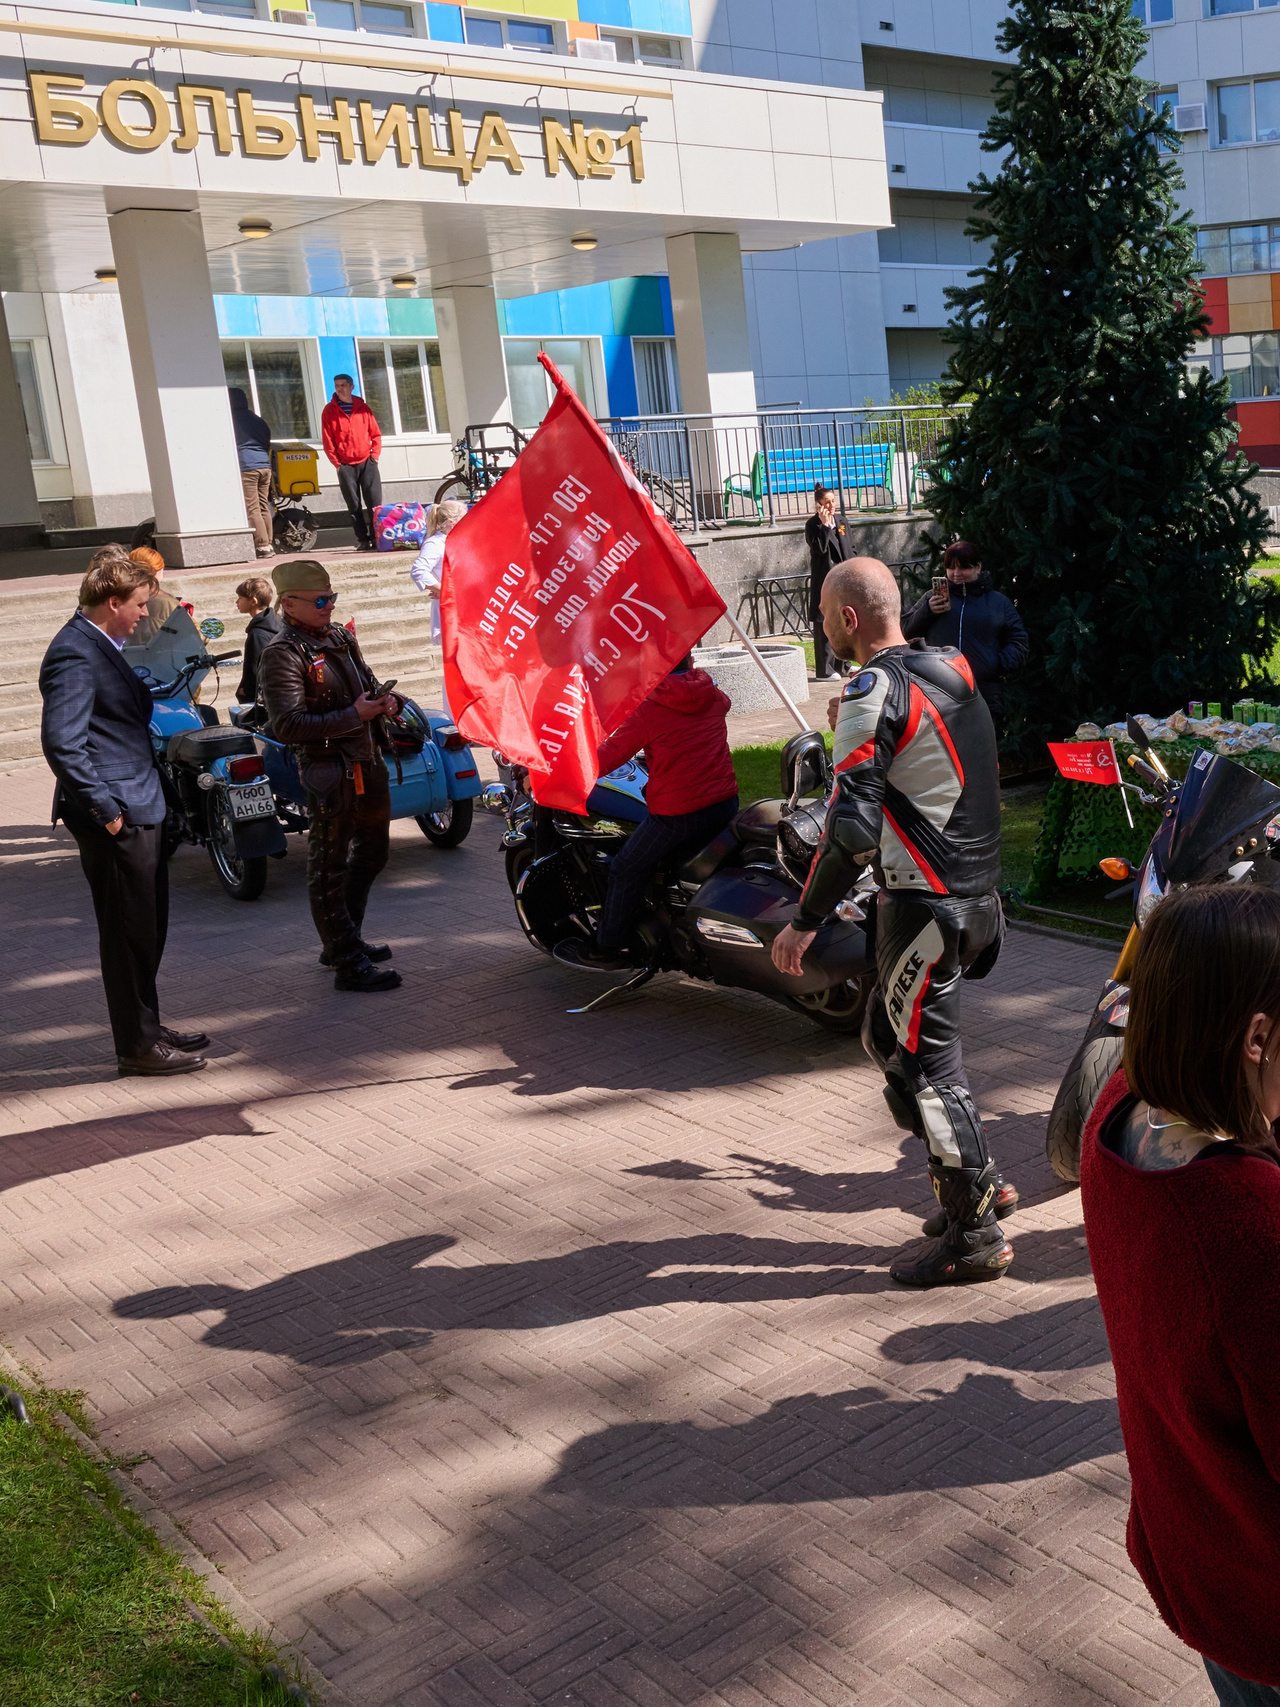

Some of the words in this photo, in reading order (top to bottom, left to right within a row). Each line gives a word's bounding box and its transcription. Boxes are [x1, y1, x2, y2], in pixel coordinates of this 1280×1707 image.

[28, 69, 526, 183] БОЛЬНИЦА
[541, 115, 647, 182] №1
[235, 786, 266, 800] 1600
[257, 801, 273, 813] 66
[976, 1183, 996, 1218] SIDI
